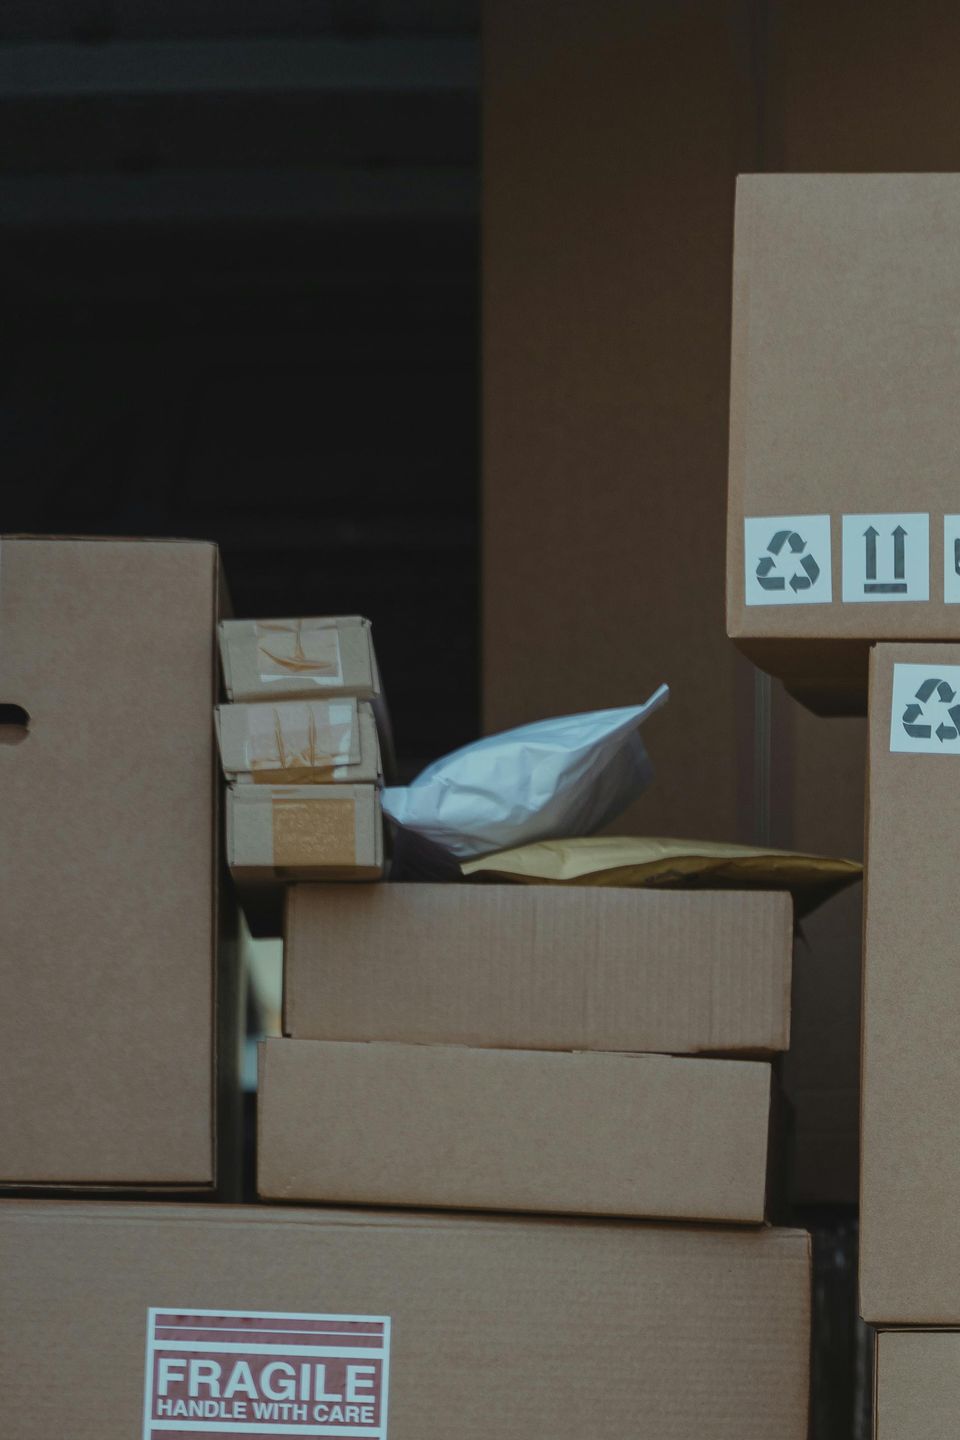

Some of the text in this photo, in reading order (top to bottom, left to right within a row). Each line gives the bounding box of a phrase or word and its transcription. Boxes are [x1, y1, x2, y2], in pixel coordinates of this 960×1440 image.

[157, 1357, 376, 1404] FRAGILE
[156, 1398, 375, 1424] HANDLE WITH CARE
